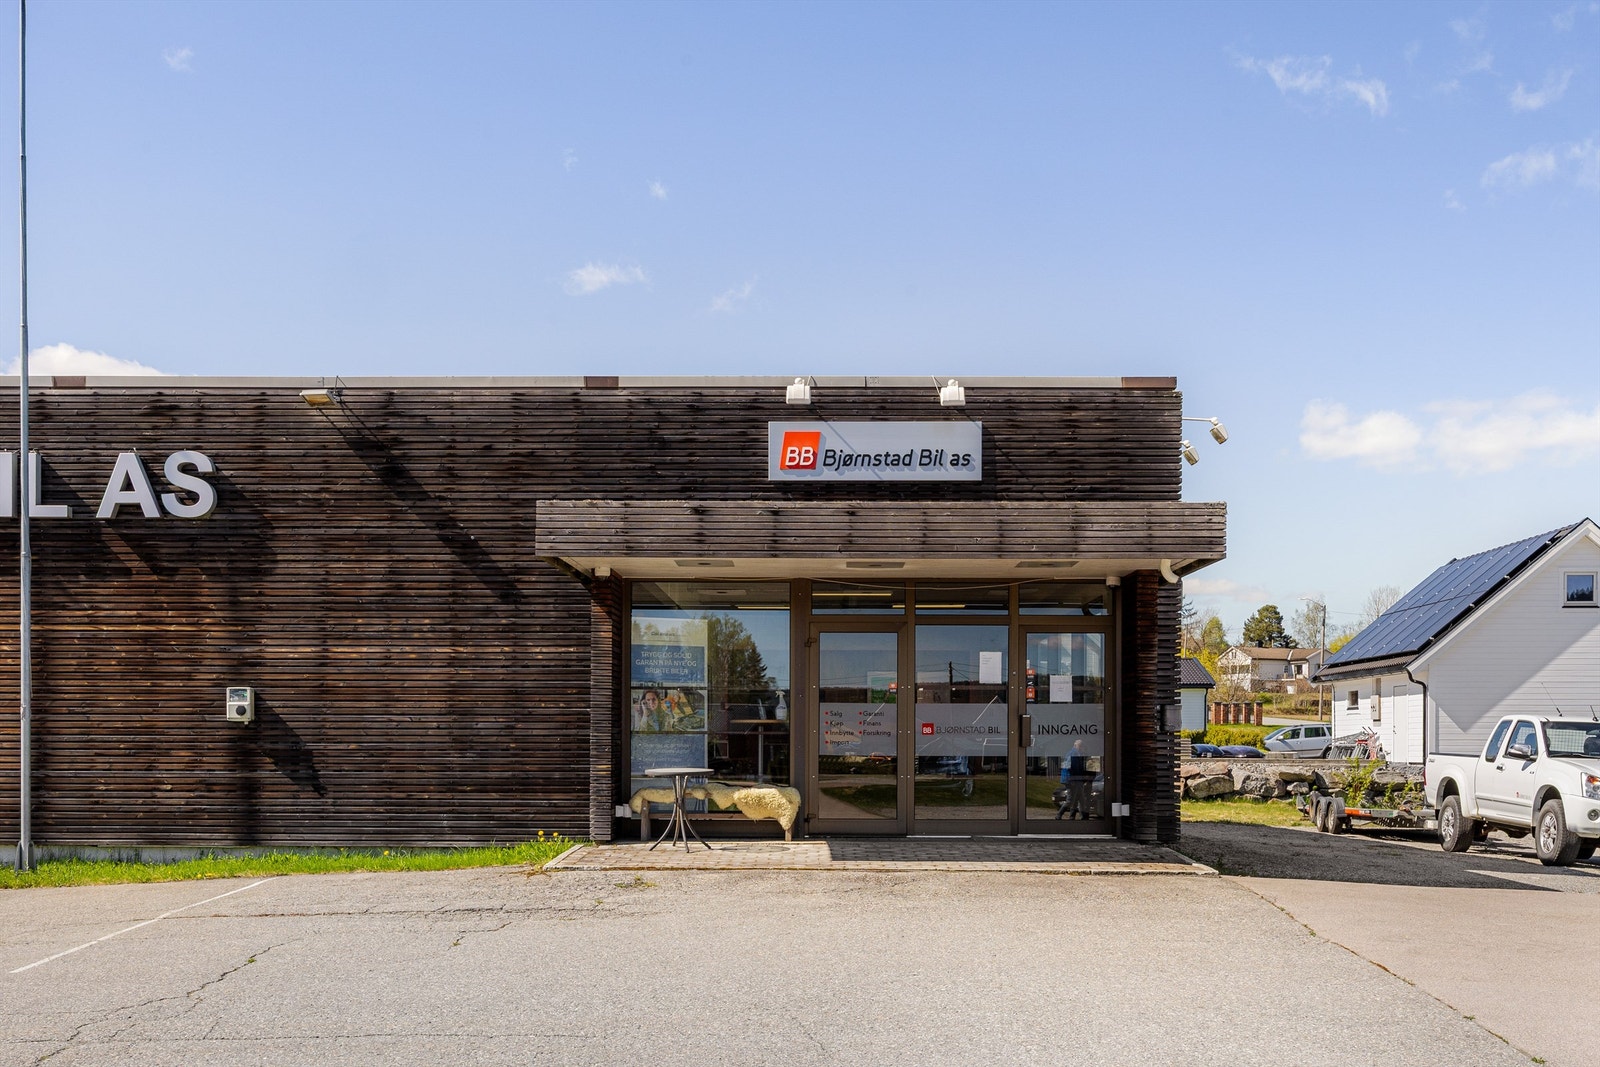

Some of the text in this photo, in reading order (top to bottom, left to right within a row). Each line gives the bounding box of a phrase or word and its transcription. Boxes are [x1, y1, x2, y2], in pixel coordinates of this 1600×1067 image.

[785, 446, 814, 466] BB
[823, 449, 971, 471] Bjørnstad Bil as
[96, 450, 217, 518] AS
[936, 726, 986, 734] BJØRNSTAD
[988, 726, 1000, 734] BIL
[1038, 724, 1098, 735] INNGANG
